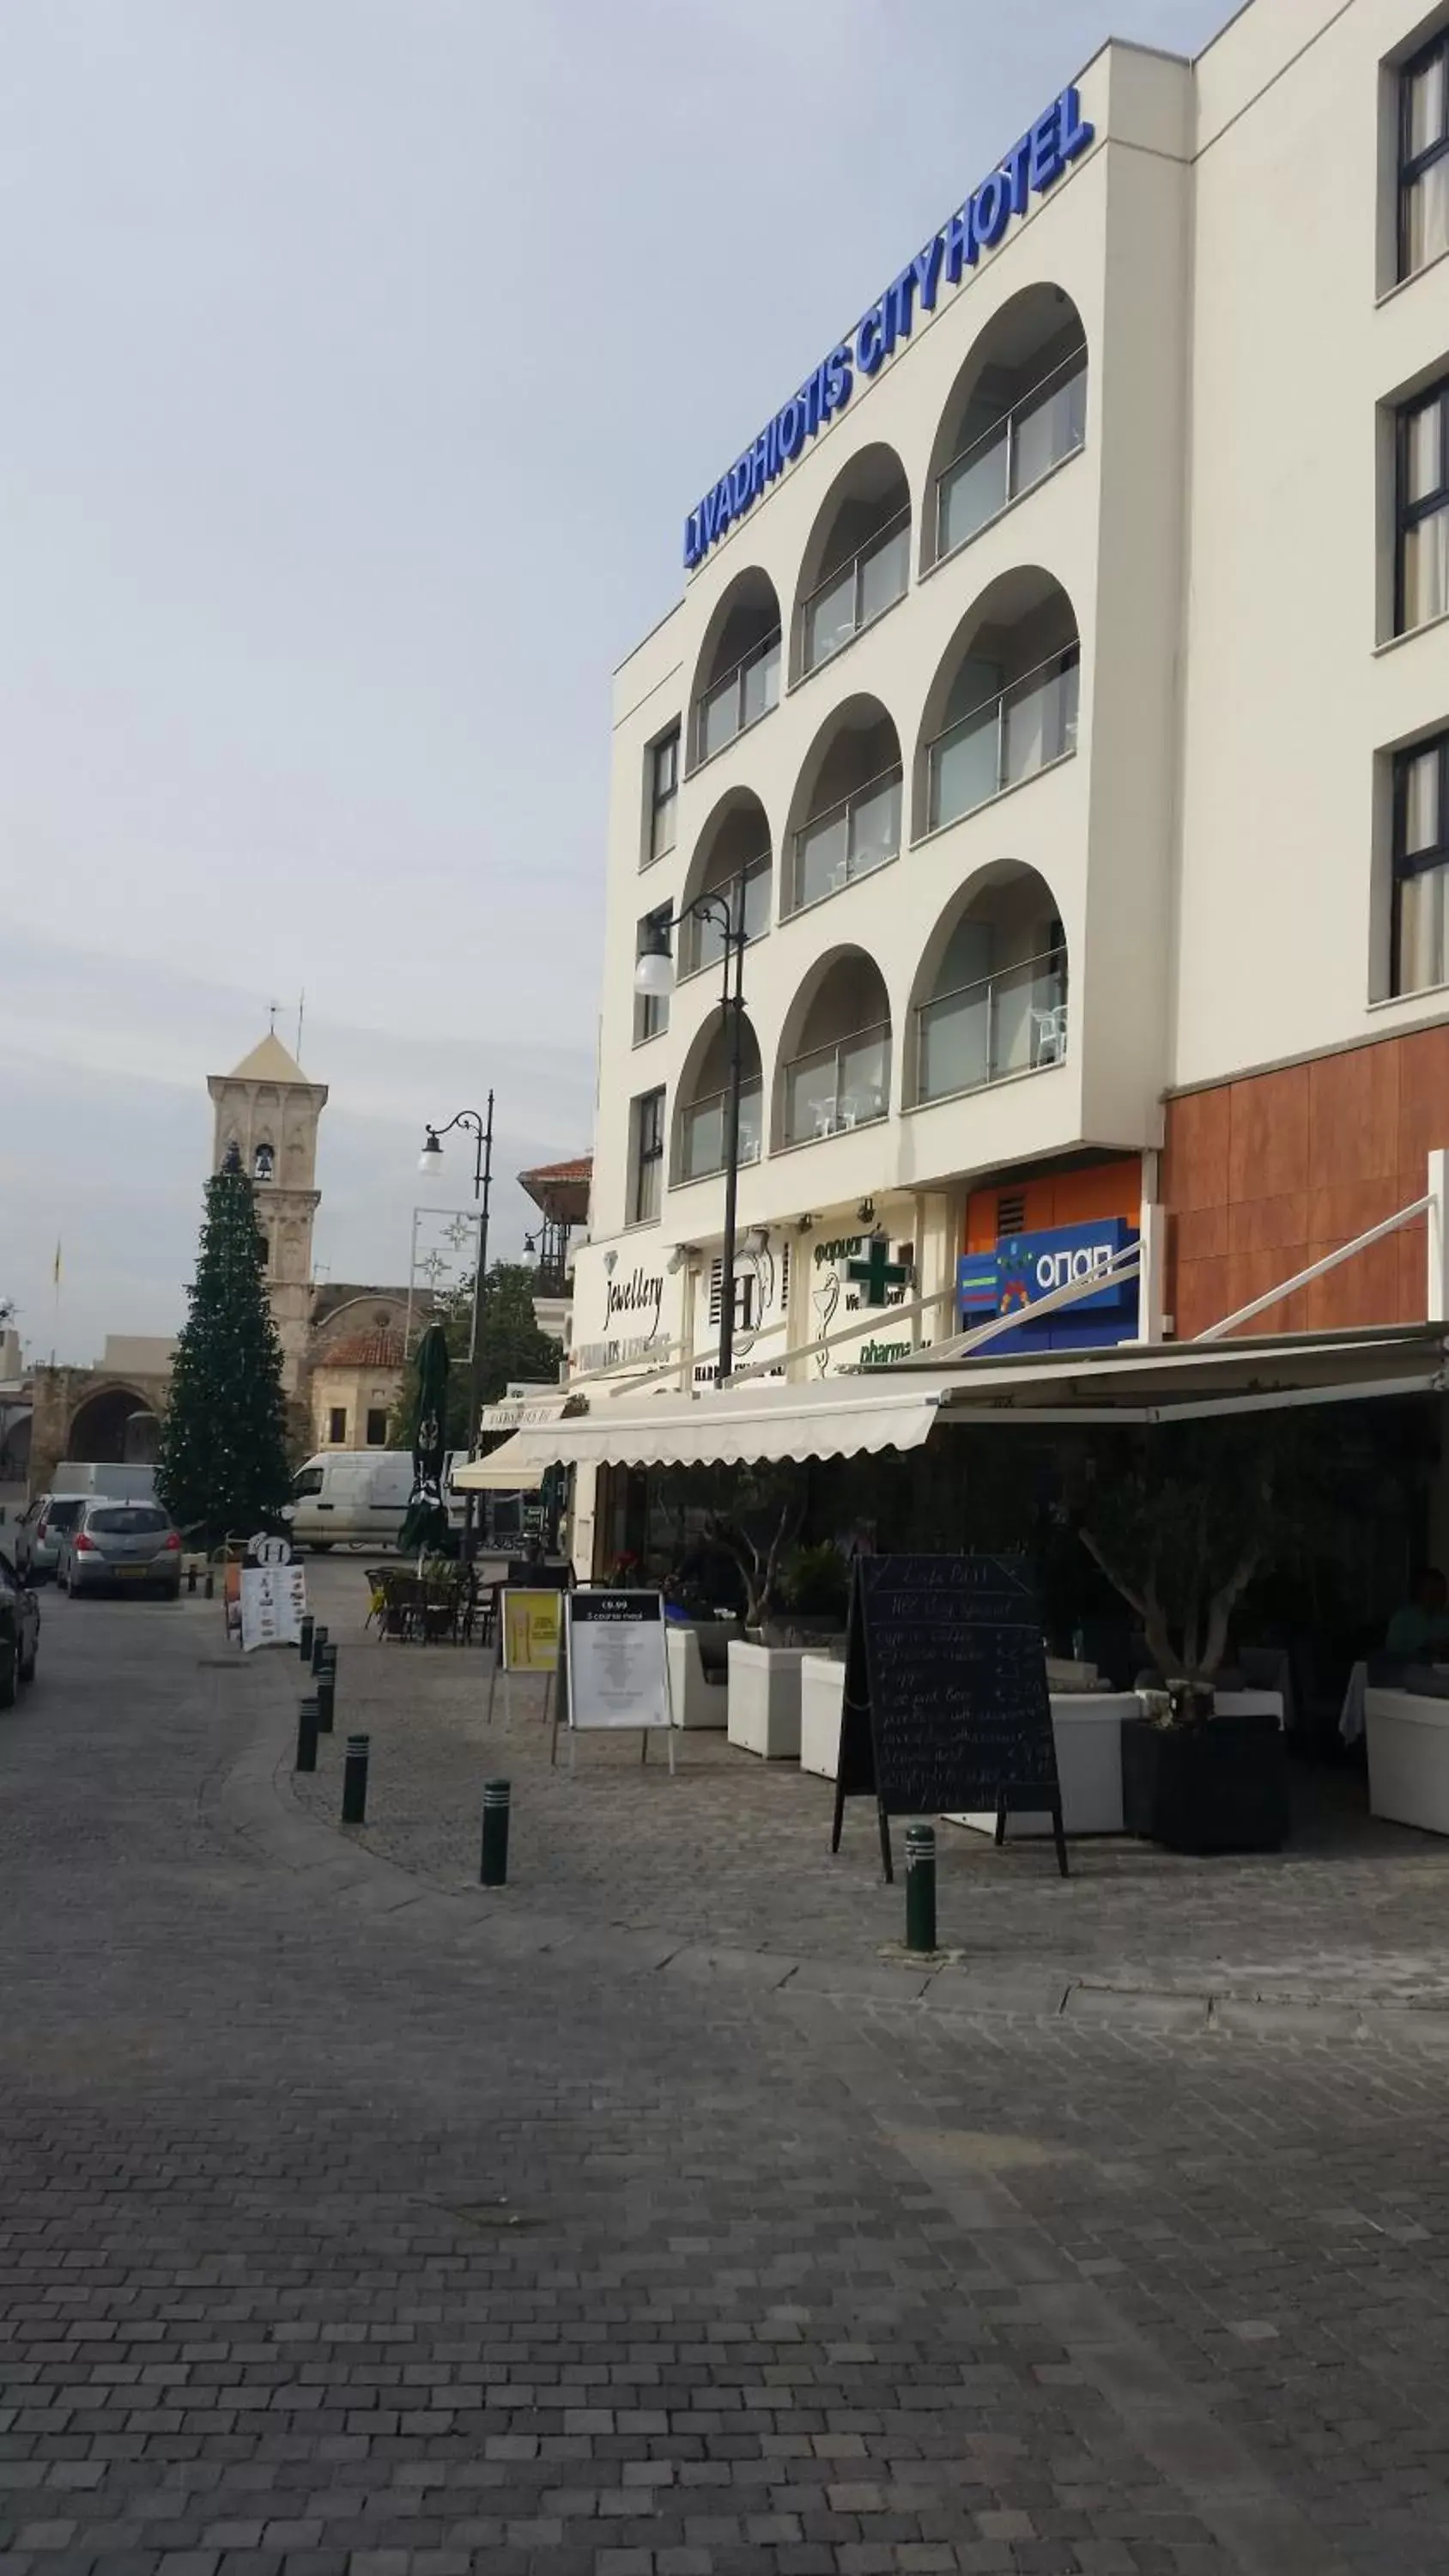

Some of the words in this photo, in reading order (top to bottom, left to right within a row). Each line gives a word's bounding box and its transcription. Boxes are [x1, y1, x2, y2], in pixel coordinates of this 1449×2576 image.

[683, 343, 853, 568] LIVADHIOTIS
[856, 235, 944, 374] CITY
[944, 87, 1094, 284] HOTEL
